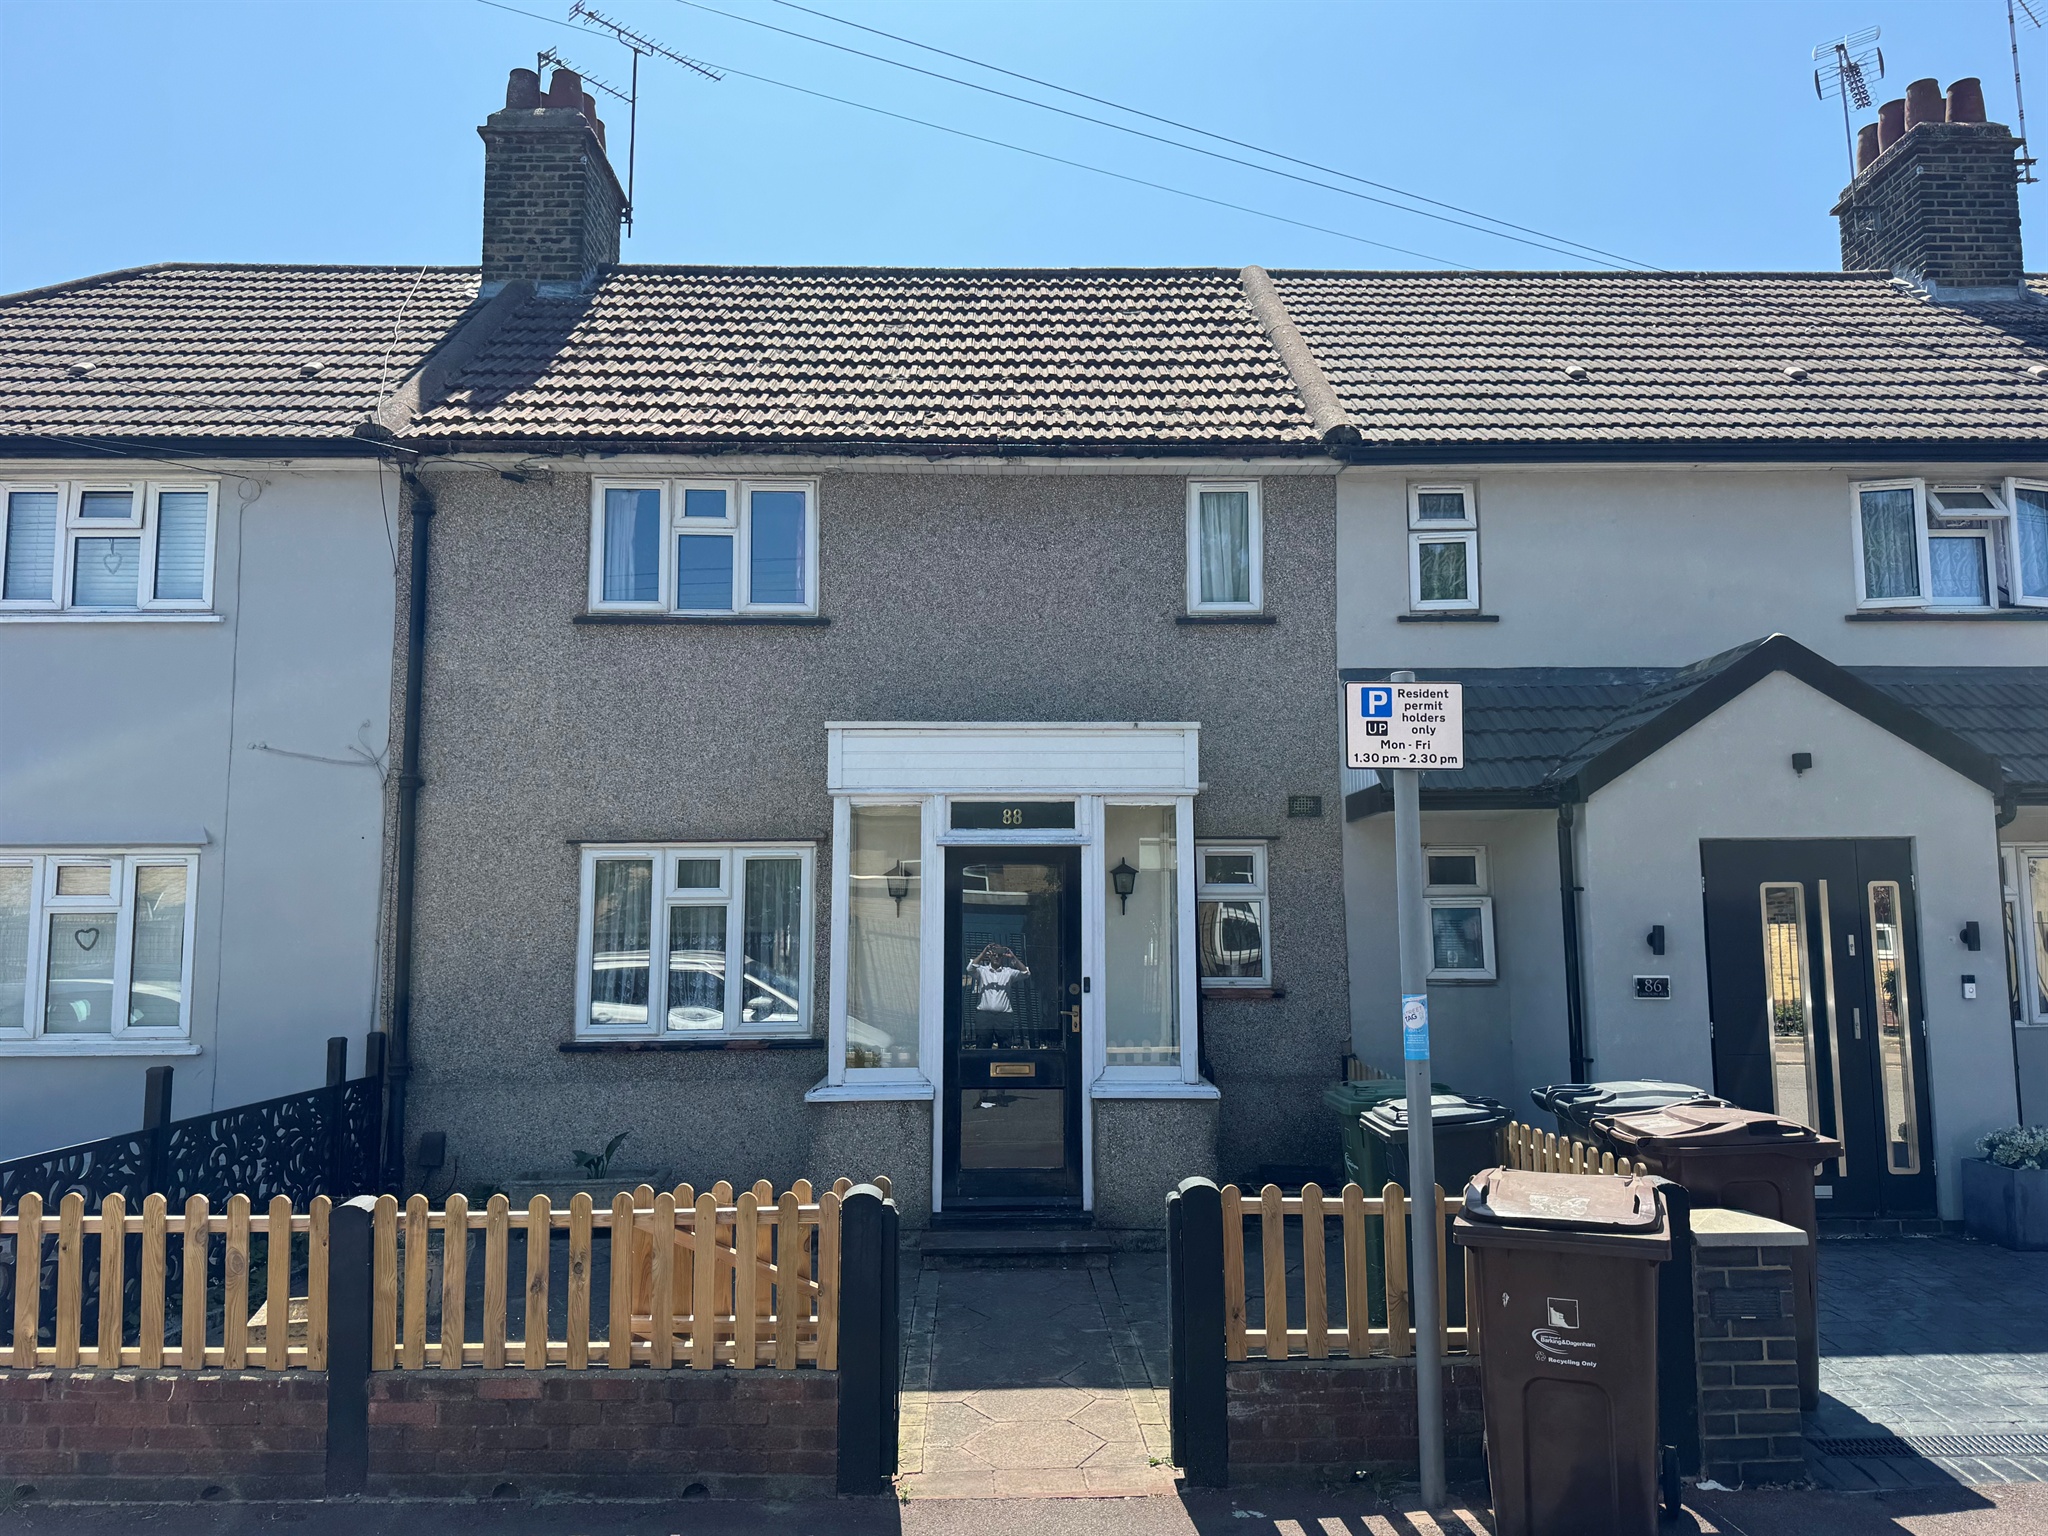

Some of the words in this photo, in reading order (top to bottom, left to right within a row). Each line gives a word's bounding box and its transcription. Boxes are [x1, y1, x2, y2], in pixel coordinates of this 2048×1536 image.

[1398, 689, 1449, 699] Resident
[1369, 691, 1388, 715] P
[1404, 701, 1443, 711] permit
[1402, 713, 1446, 722] holders
[1368, 723, 1387, 734] UP
[1411, 725, 1436, 736] only
[1380, 740, 1405, 749] Mon
[1416, 740, 1431, 749] Fri
[1354, 753, 1379, 763] 1.30
[1382, 755, 1399, 765] pm
[1409, 754, 1437, 763] 2.30
[1440, 756, 1458, 765] pm
[1002, 808, 1023, 825] 88
[1644, 979, 1662, 992] 86
[1548, 1357, 1580, 1367] Recycling
[1581, 1360, 1597, 1368] Only
